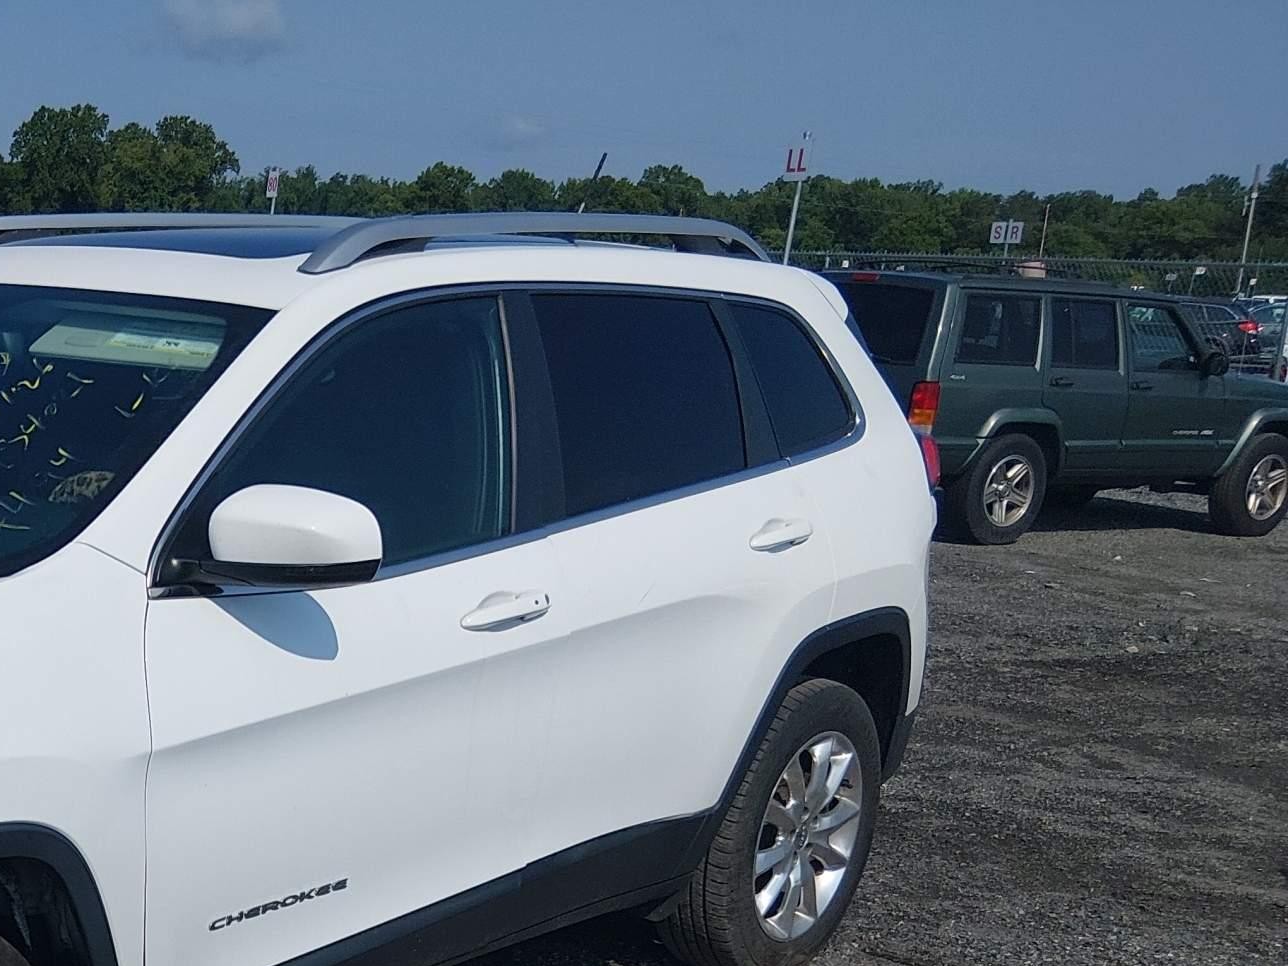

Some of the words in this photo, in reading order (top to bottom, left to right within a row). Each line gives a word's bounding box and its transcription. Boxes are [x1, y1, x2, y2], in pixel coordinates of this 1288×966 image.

[785, 148, 807, 173] LL
[993, 225, 1003, 240] S
[1010, 225, 1020, 241] R
[209, 878, 349, 931] CHEROKEE
